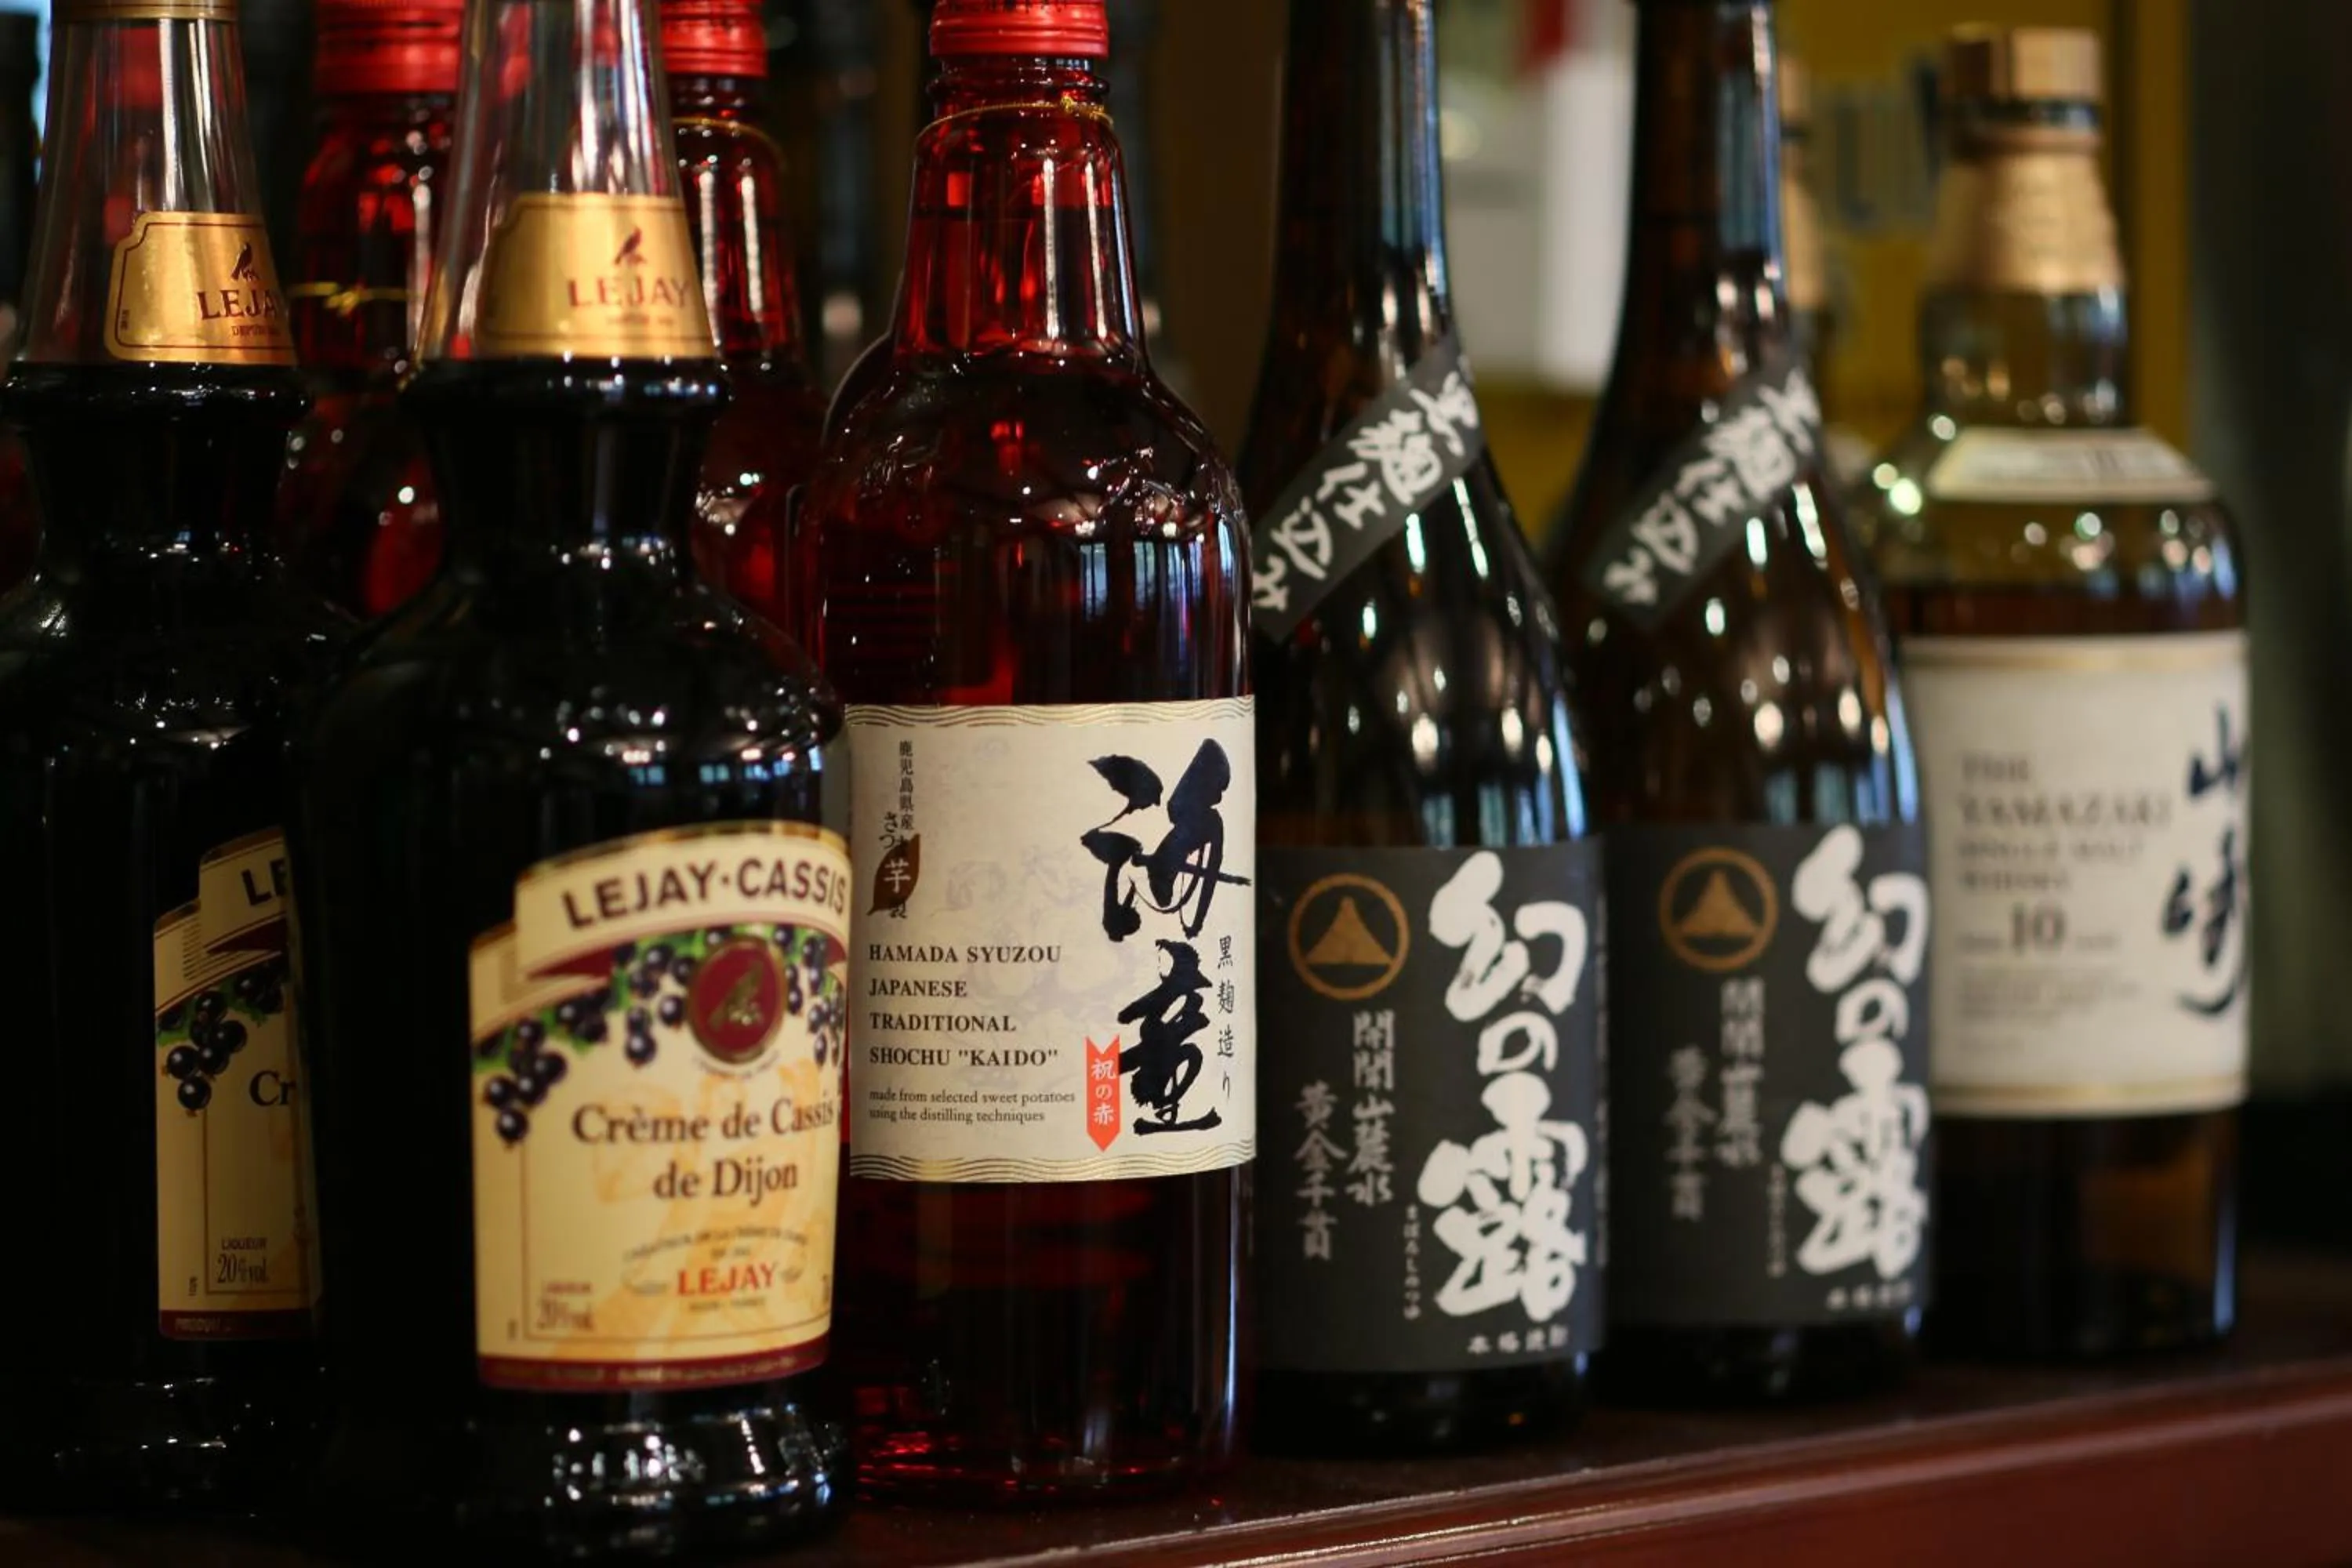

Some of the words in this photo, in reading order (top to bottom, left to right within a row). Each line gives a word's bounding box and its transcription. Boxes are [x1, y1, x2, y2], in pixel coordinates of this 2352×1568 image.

[198, 289, 278, 320] LEJA
[568, 276, 691, 310] LEJAY
[898, 739, 915, 830] 鹿児島県産
[1080, 738, 1251, 1136] 海童
[869, 945, 958, 963] HAMADA
[967, 946, 1062, 964] SYUZOU
[869, 978, 967, 997] JAPANESE
[869, 1012, 1017, 1032] TRADITIONAL
[1217, 935, 1236, 1101] 黒麹造り
[869, 1047, 951, 1065] SHOCHU
[958, 1049, 1058, 1066] "KAIDO"
[869, 1089, 895, 1102] made
[899, 1089, 927, 1102] from
[931, 1090, 978, 1103] selected
[982, 1091, 1018, 1104] sweet
[1021, 1091, 1076, 1106] potatoes
[1091, 1058, 1117, 1126] 祝の赤
[572, 1103, 710, 1144] Crème
[720, 1102, 761, 1138] de
[770, 1090, 836, 1135] Cassis
[869, 1109, 897, 1122] using
[900, 1107, 916, 1121] the
[920, 1107, 973, 1124] distilling
[976, 1108, 1046, 1124] techniques
[652, 1160, 700, 1200] de
[711, 1156, 798, 1208] Dijon
[677, 1261, 778, 1297] LEJAY
